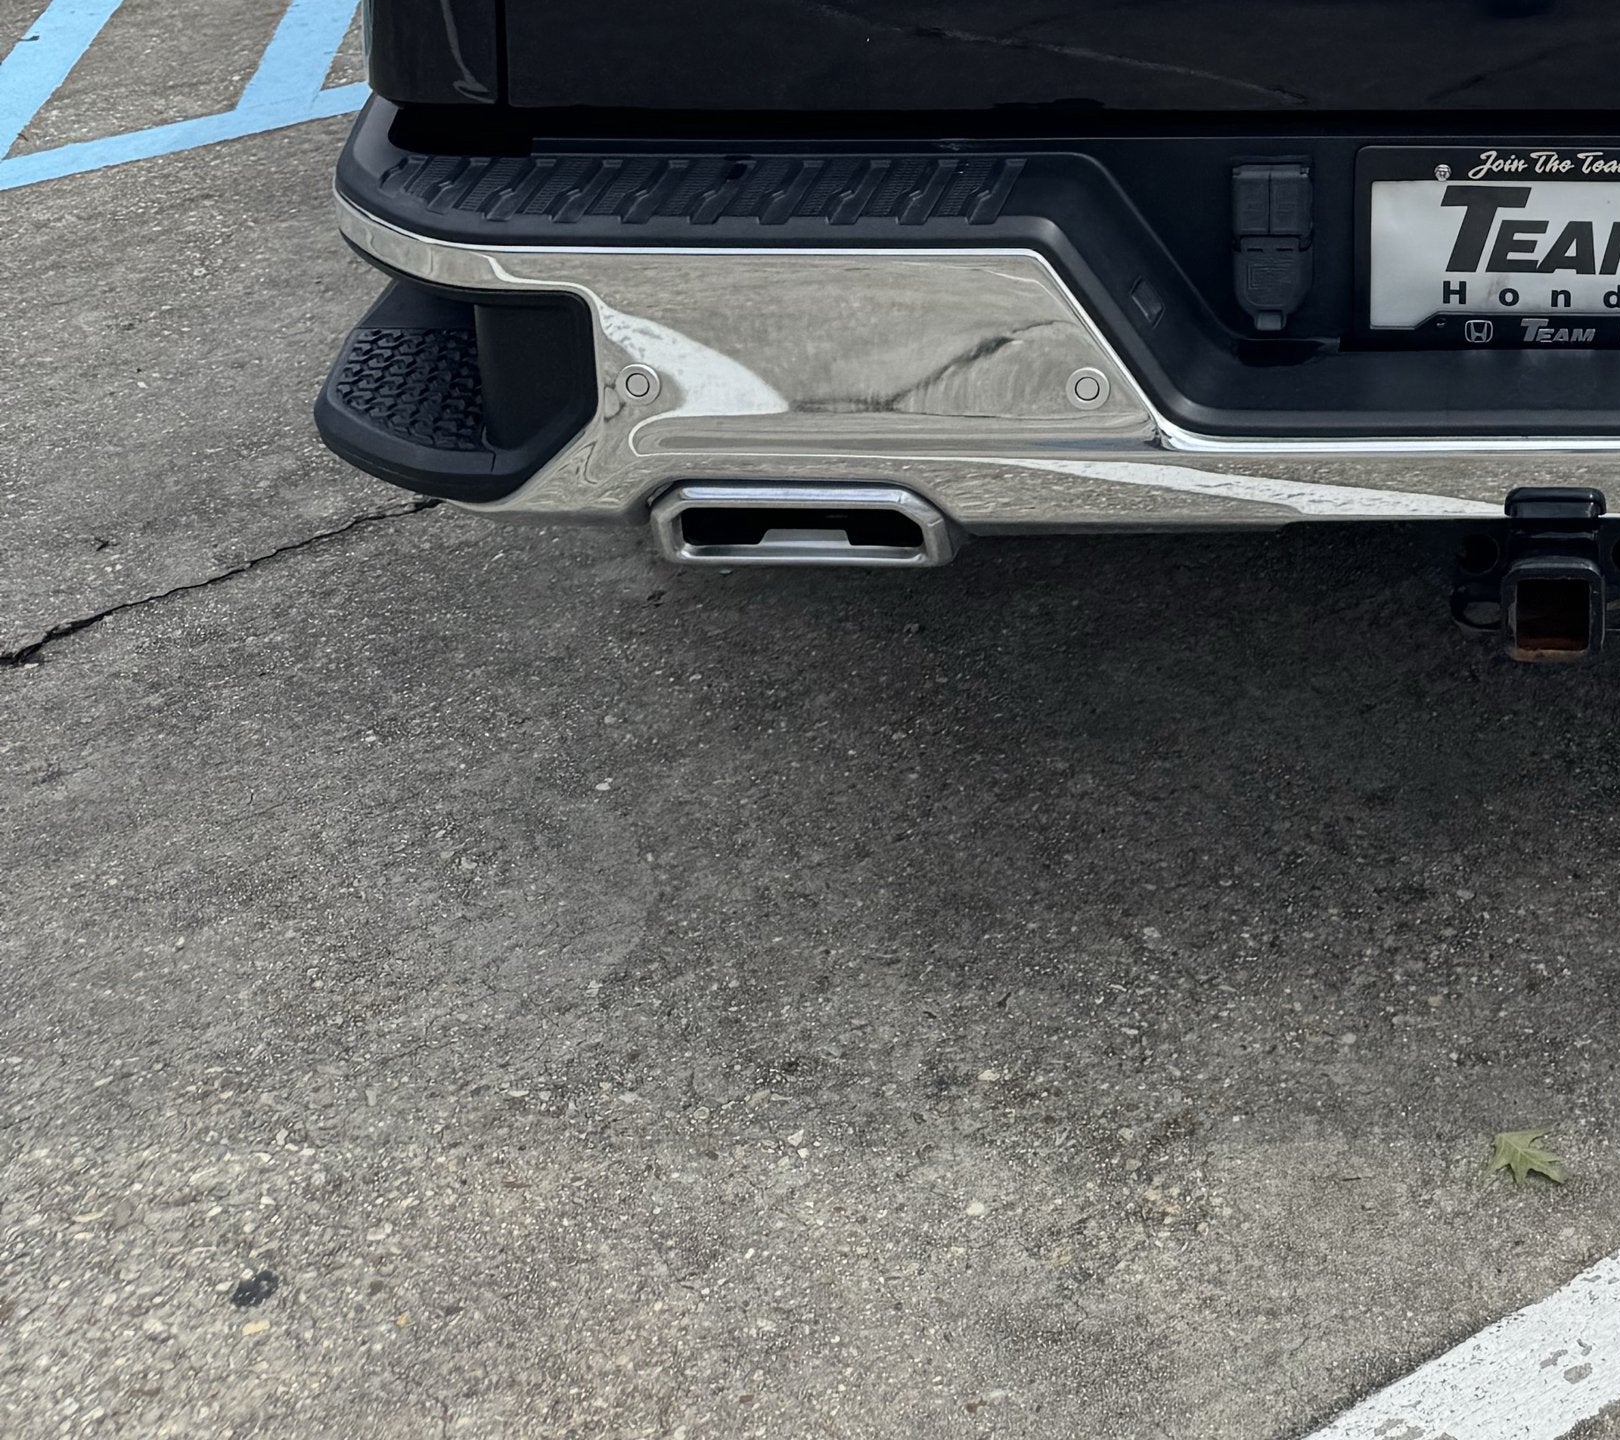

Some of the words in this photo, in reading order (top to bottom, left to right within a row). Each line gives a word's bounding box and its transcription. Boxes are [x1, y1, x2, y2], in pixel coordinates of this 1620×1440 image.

[1467, 149, 1528, 180] Join
[1530, 151, 1575, 174] The
[1520, 318, 1596, 343] TEAM
